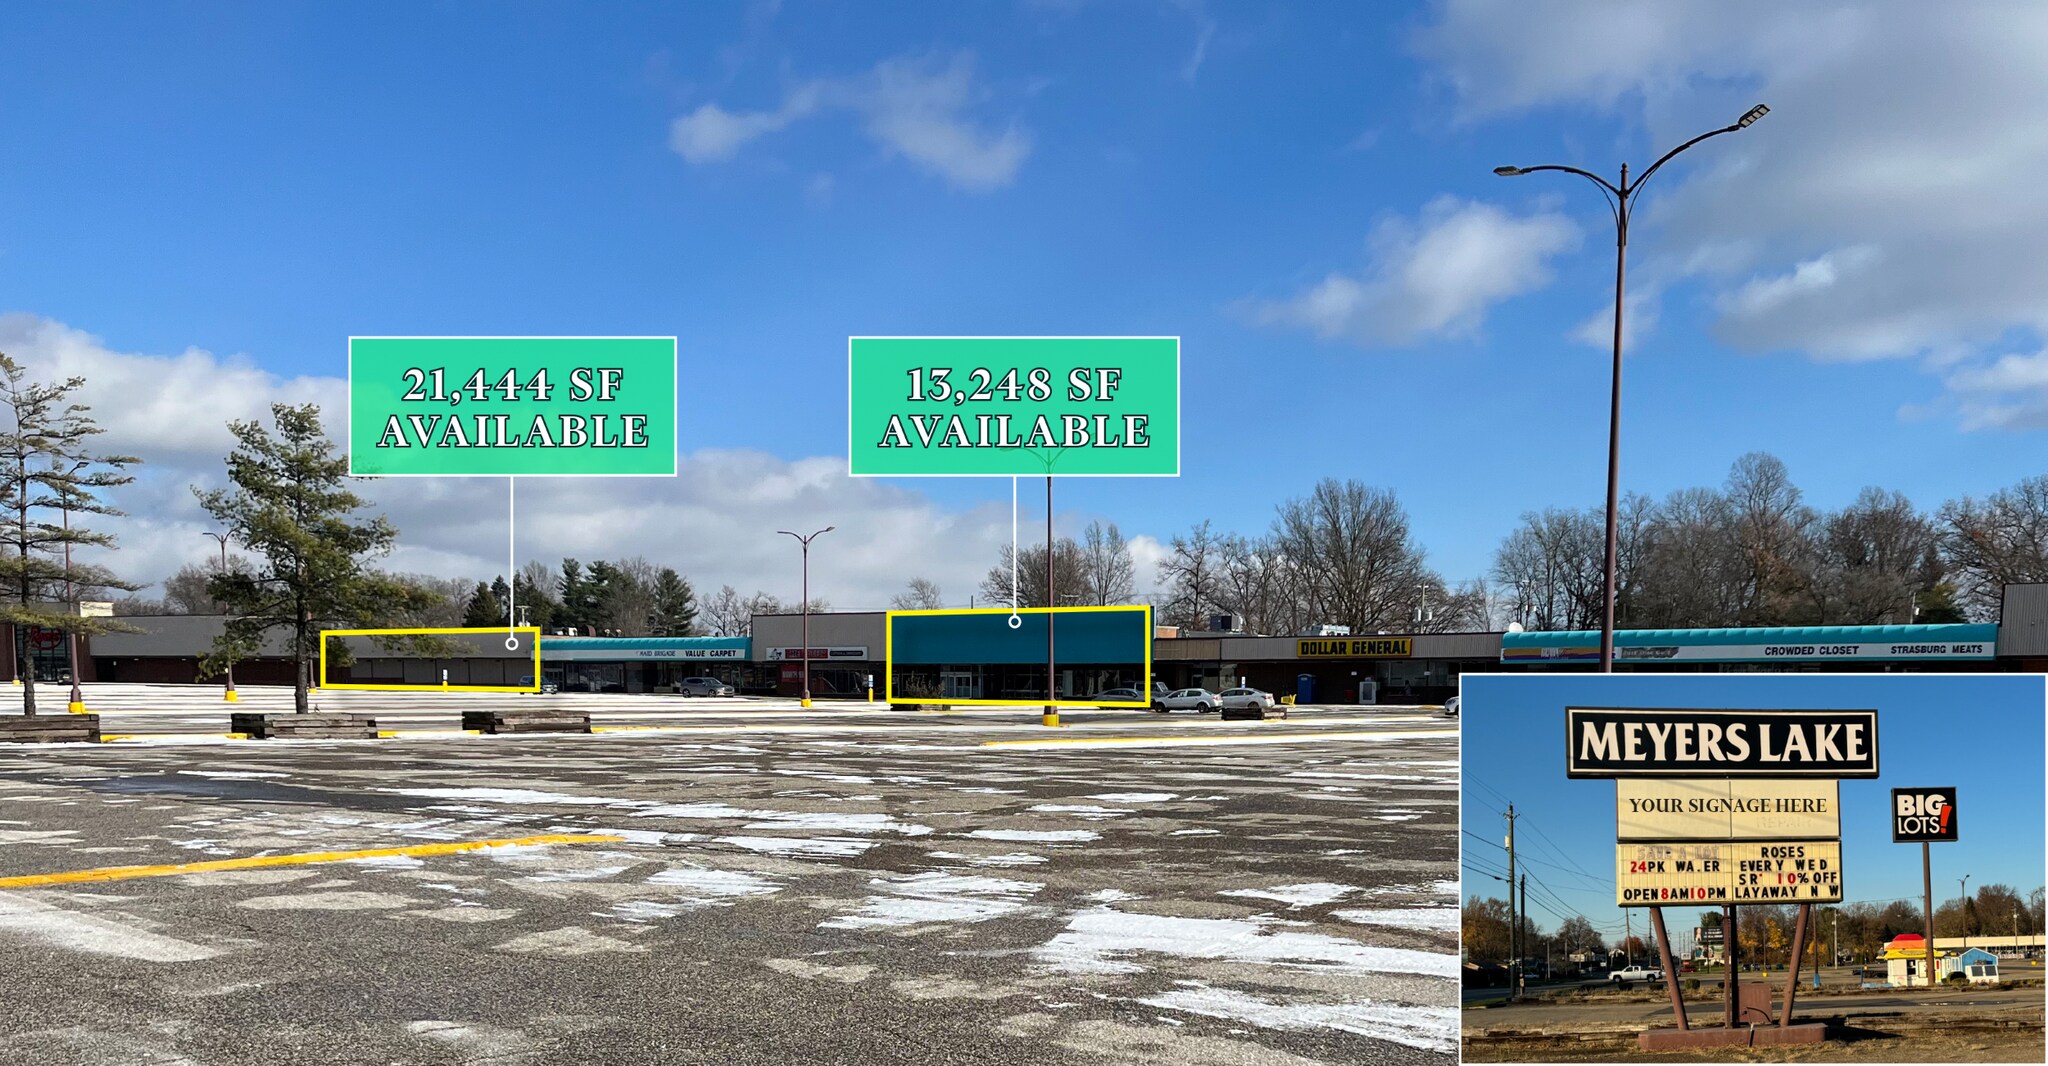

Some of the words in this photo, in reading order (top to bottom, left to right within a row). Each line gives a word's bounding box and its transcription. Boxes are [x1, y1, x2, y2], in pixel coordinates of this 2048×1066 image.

[1301, 641, 1347, 655] DOLLAR
[1352, 640, 1408, 655] GENERAL
[1764, 646, 1815, 656] CROWDED
[1819, 645, 1859, 655] CLOSET
[1890, 645, 1947, 654] STRASBURG
[1951, 644, 1983, 654] MEATS
[1580, 721, 1751, 762] MEYERS
[1758, 723, 1868, 762] LAKE
[1896, 794, 1948, 817] BIG
[1761, 846, 1805, 858] ROSES
[1630, 861, 1665, 873] 24PK
[1740, 860, 1784, 872] EVERY
[1795, 859, 1828, 871] WED
[1813, 872, 1838, 883] OFF
[1735, 887, 1798, 899] LAYAWAY
